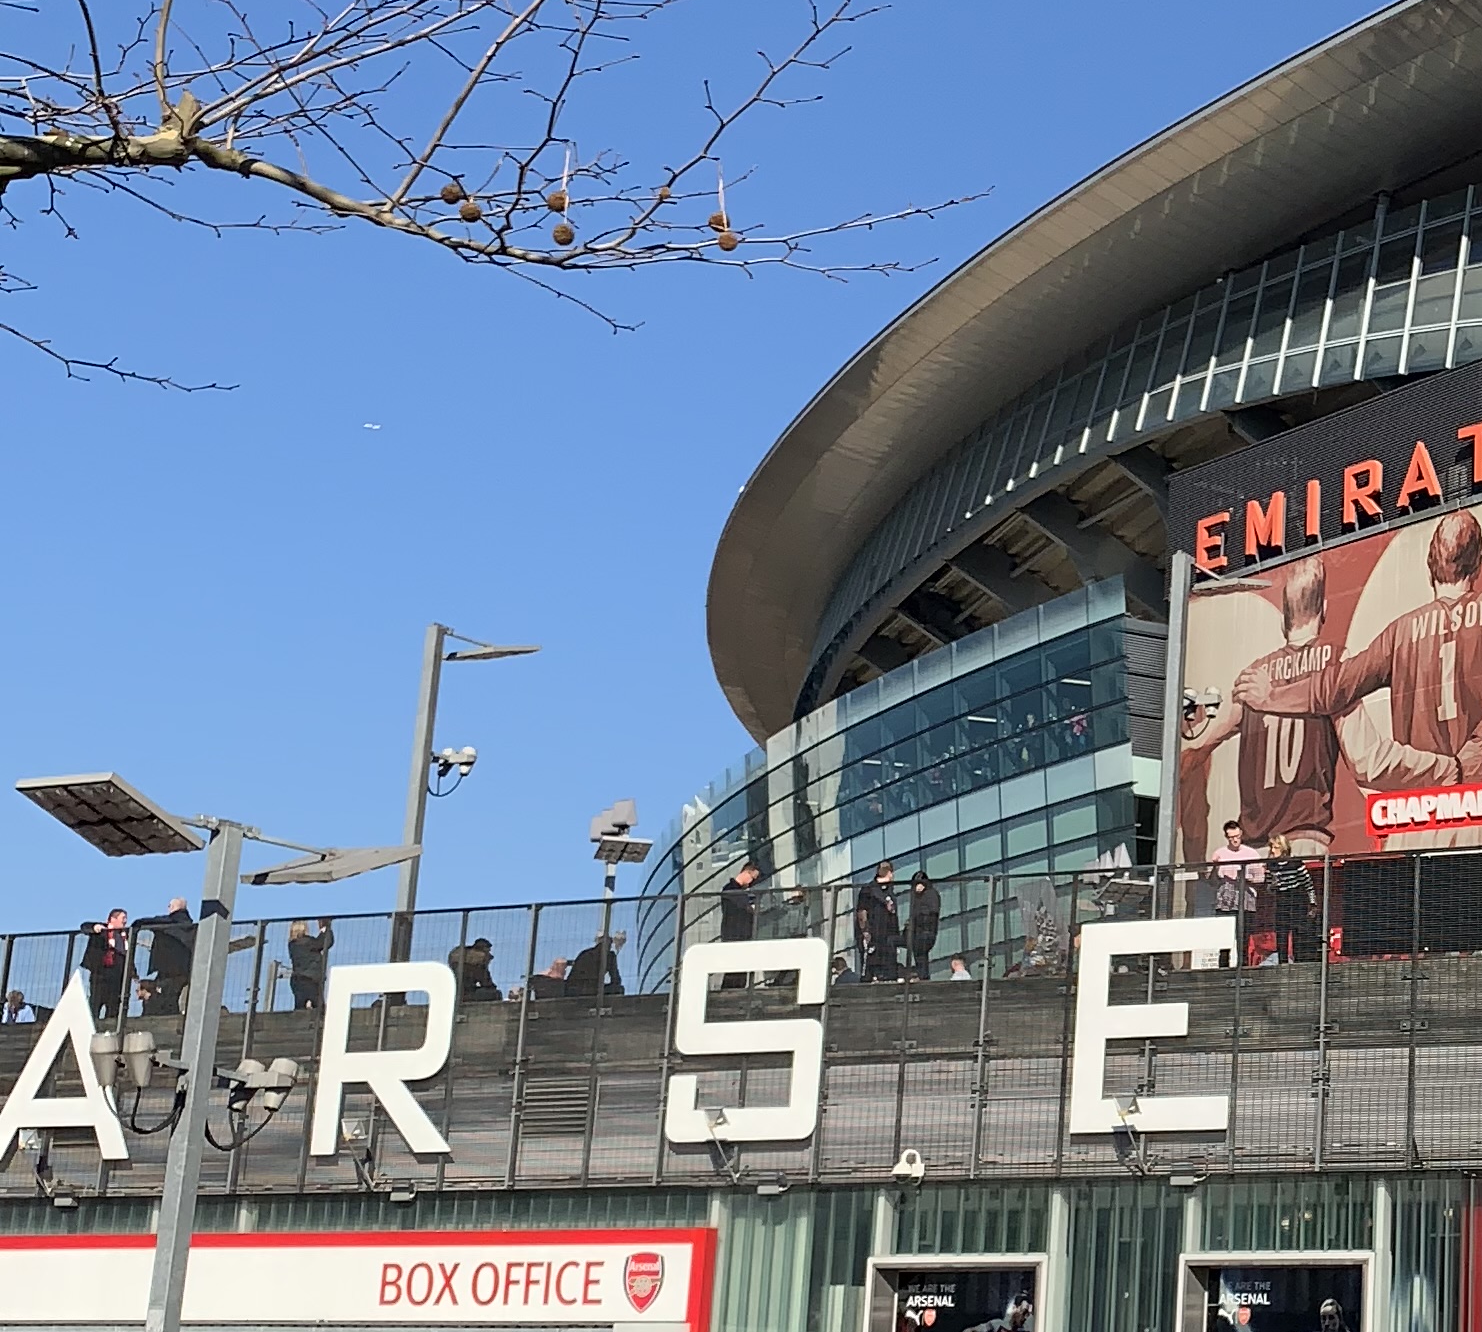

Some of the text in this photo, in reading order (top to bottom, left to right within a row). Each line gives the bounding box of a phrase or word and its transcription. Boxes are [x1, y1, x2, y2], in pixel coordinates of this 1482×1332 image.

[1437, 641, 1457, 721] 1
[1263, 715, 1304, 788] 10
[379, 1261, 605, 1306] BOX OFFICE
[940, 1284, 956, 1292] THE
[1254, 1282, 1271, 1290] THE
[906, 1295, 955, 1308] ARSENAL
[1218, 1293, 1271, 1305] ARSENAL
